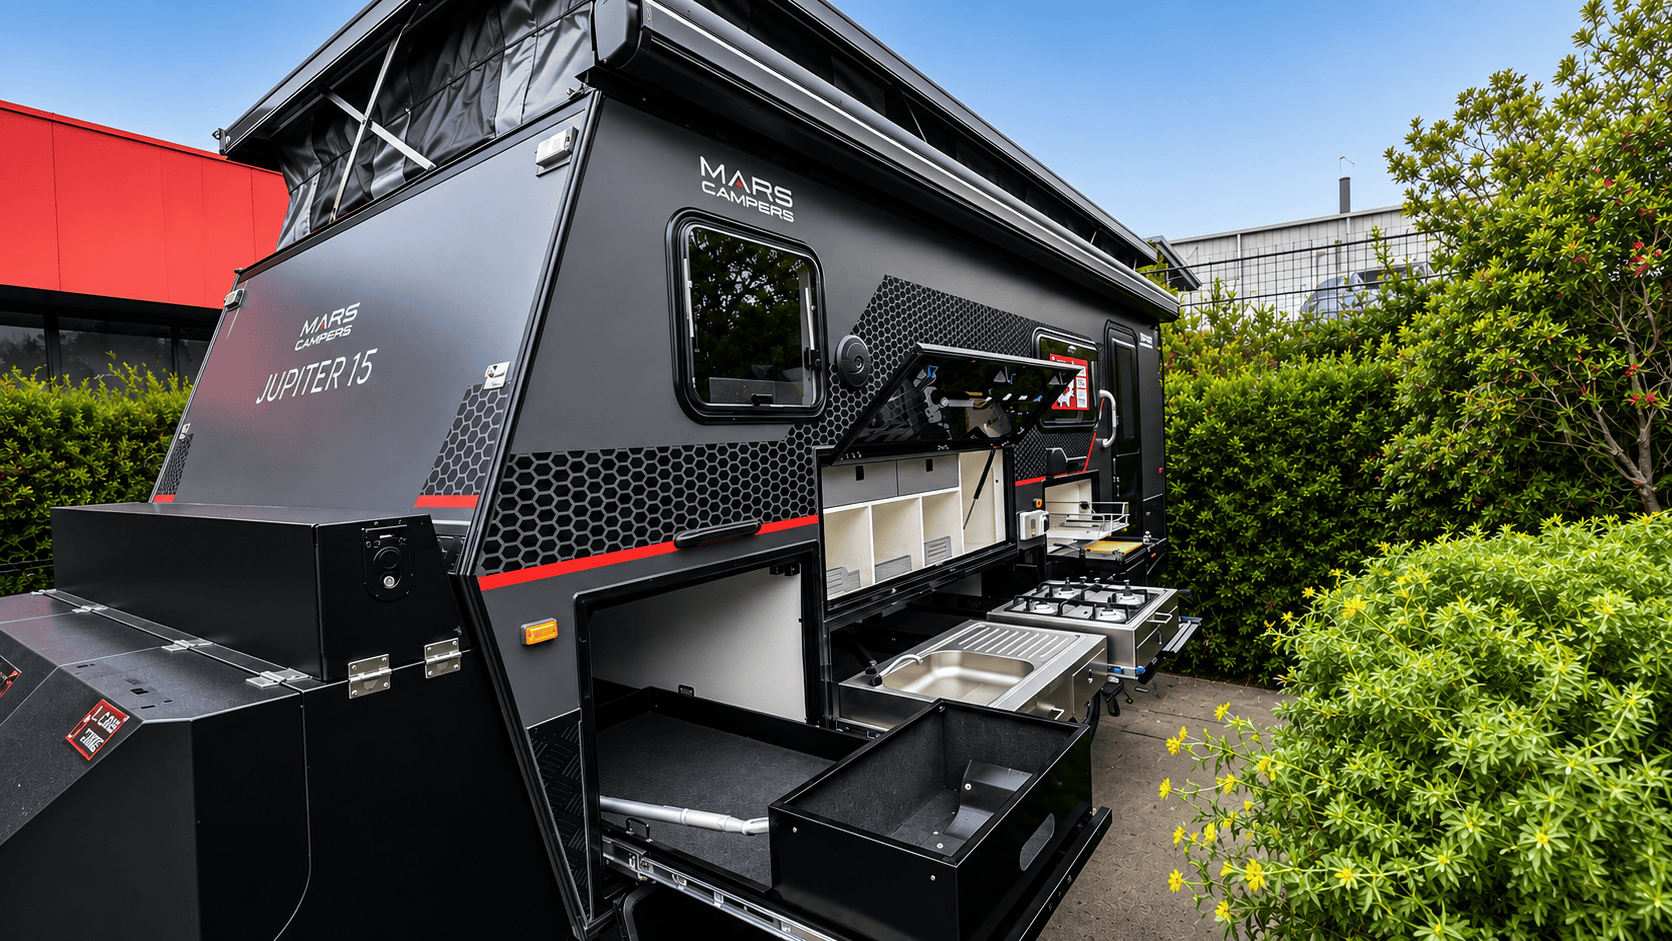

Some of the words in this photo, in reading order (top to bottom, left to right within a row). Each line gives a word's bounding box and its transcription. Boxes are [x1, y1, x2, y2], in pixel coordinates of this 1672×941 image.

[700, 155, 793, 208] MARS
[701, 180, 795, 223] CAMPERS
[294, 324, 353, 351] CAMPERS
[300, 302, 361, 338] MARS
[256, 356, 347, 404] JUPITER
[347, 348, 378, 387] 15
